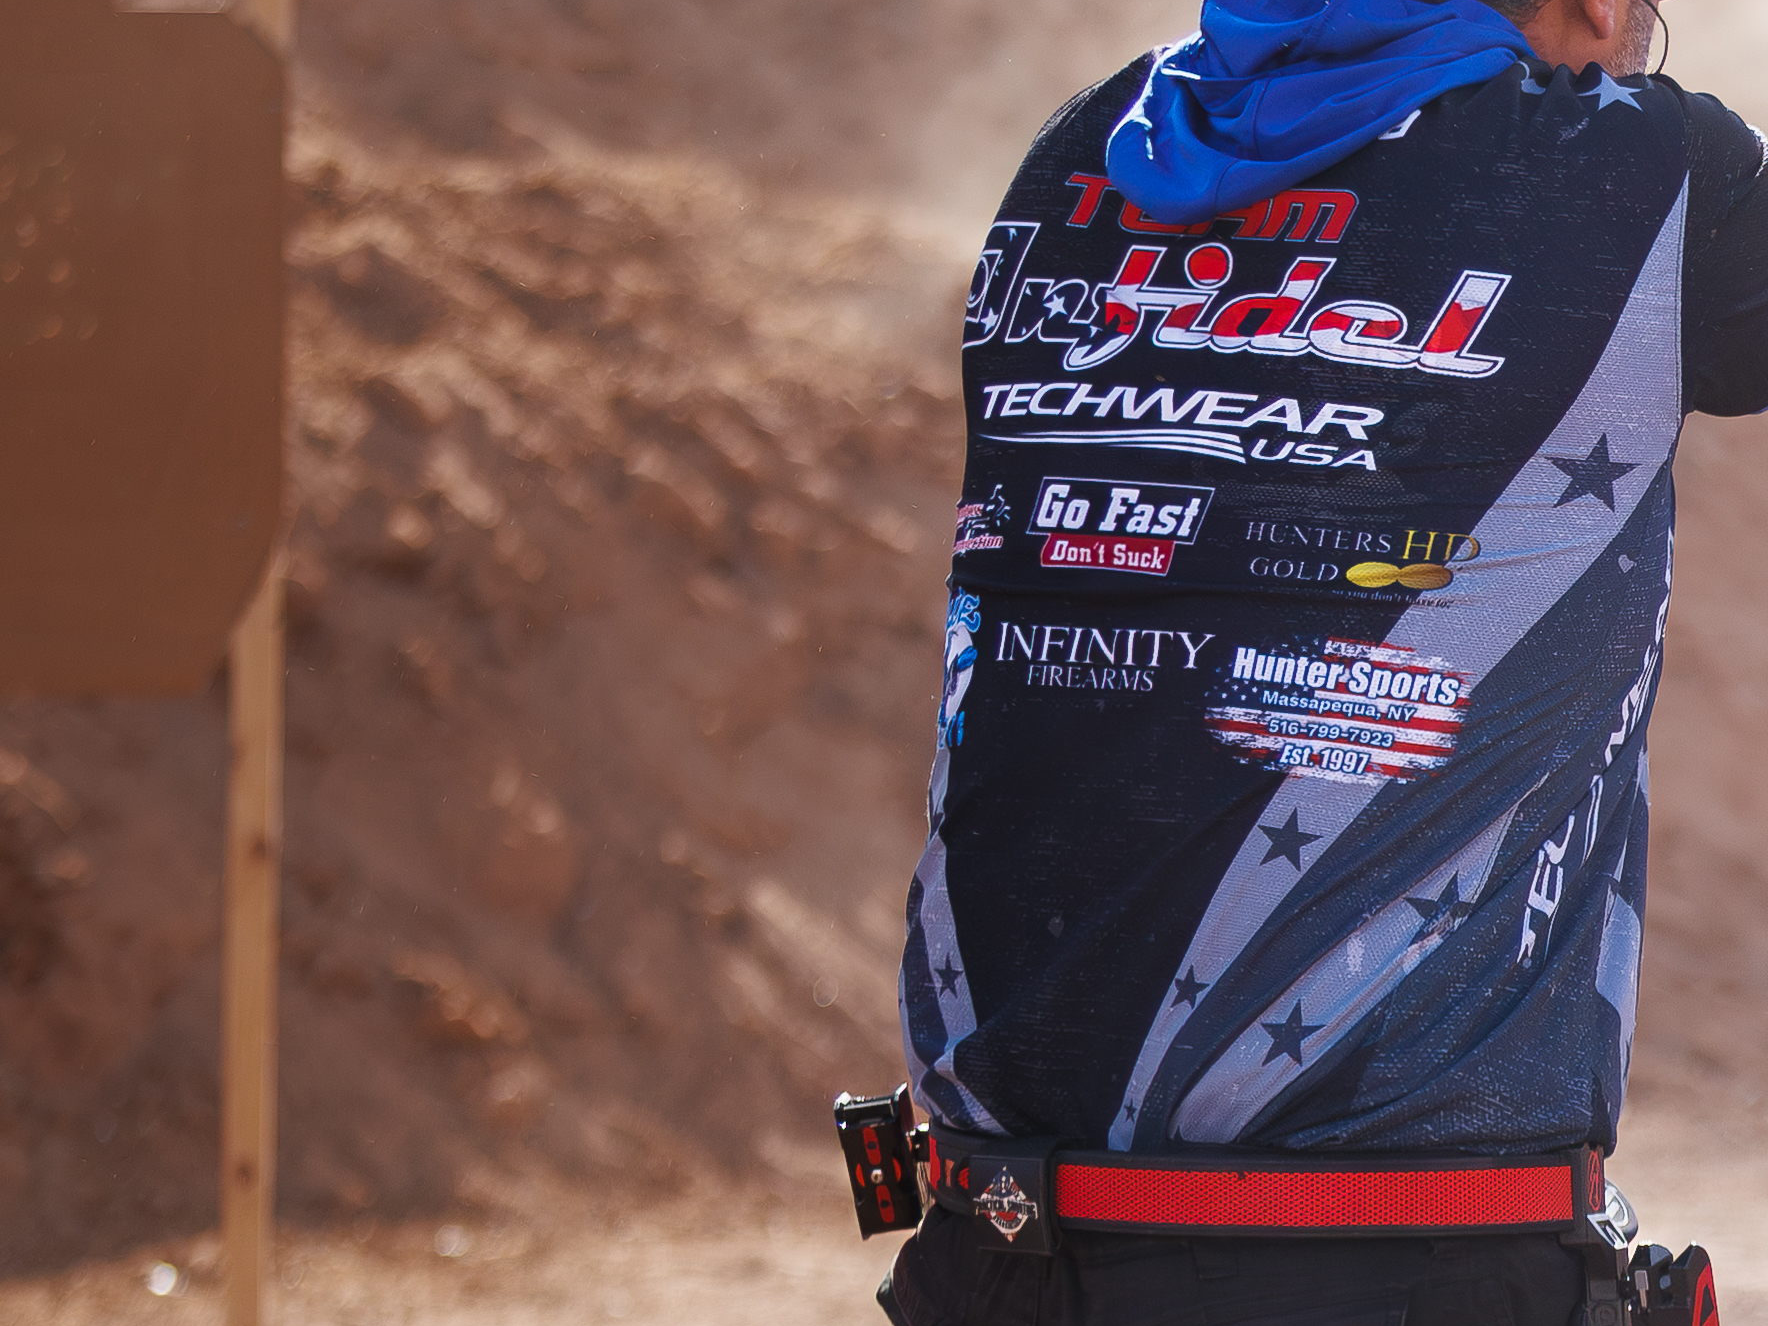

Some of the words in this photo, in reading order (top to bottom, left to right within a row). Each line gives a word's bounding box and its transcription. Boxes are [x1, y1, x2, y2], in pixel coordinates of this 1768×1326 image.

[962, 221, 1512, 378] Infidel
[982, 382, 1385, 440] TECHWEAR
[1249, 439, 1378, 472] USA
[1036, 485, 1090, 531] Go
[1099, 489, 1202, 537] Fast
[1050, 540, 1106, 565] Don't
[1113, 545, 1166, 570] Suck
[1245, 521, 1393, 553] HUNTERS
[1402, 529, 1481, 562] HD
[1249, 556, 1339, 582] GOLD
[995, 621, 1217, 670] INFINITY
[1026, 664, 1155, 692] FIREARMS
[1231, 646, 1345, 691] Hunter
[1348, 660, 1461, 706] Sports
[1261, 689, 1383, 721] Massapequa,
[1387, 705, 1418, 722] NY
[1268, 719, 1395, 748] 516-799-7923
[1279, 744, 1315, 768] Est.
[1319, 748, 1373, 774] 1997
